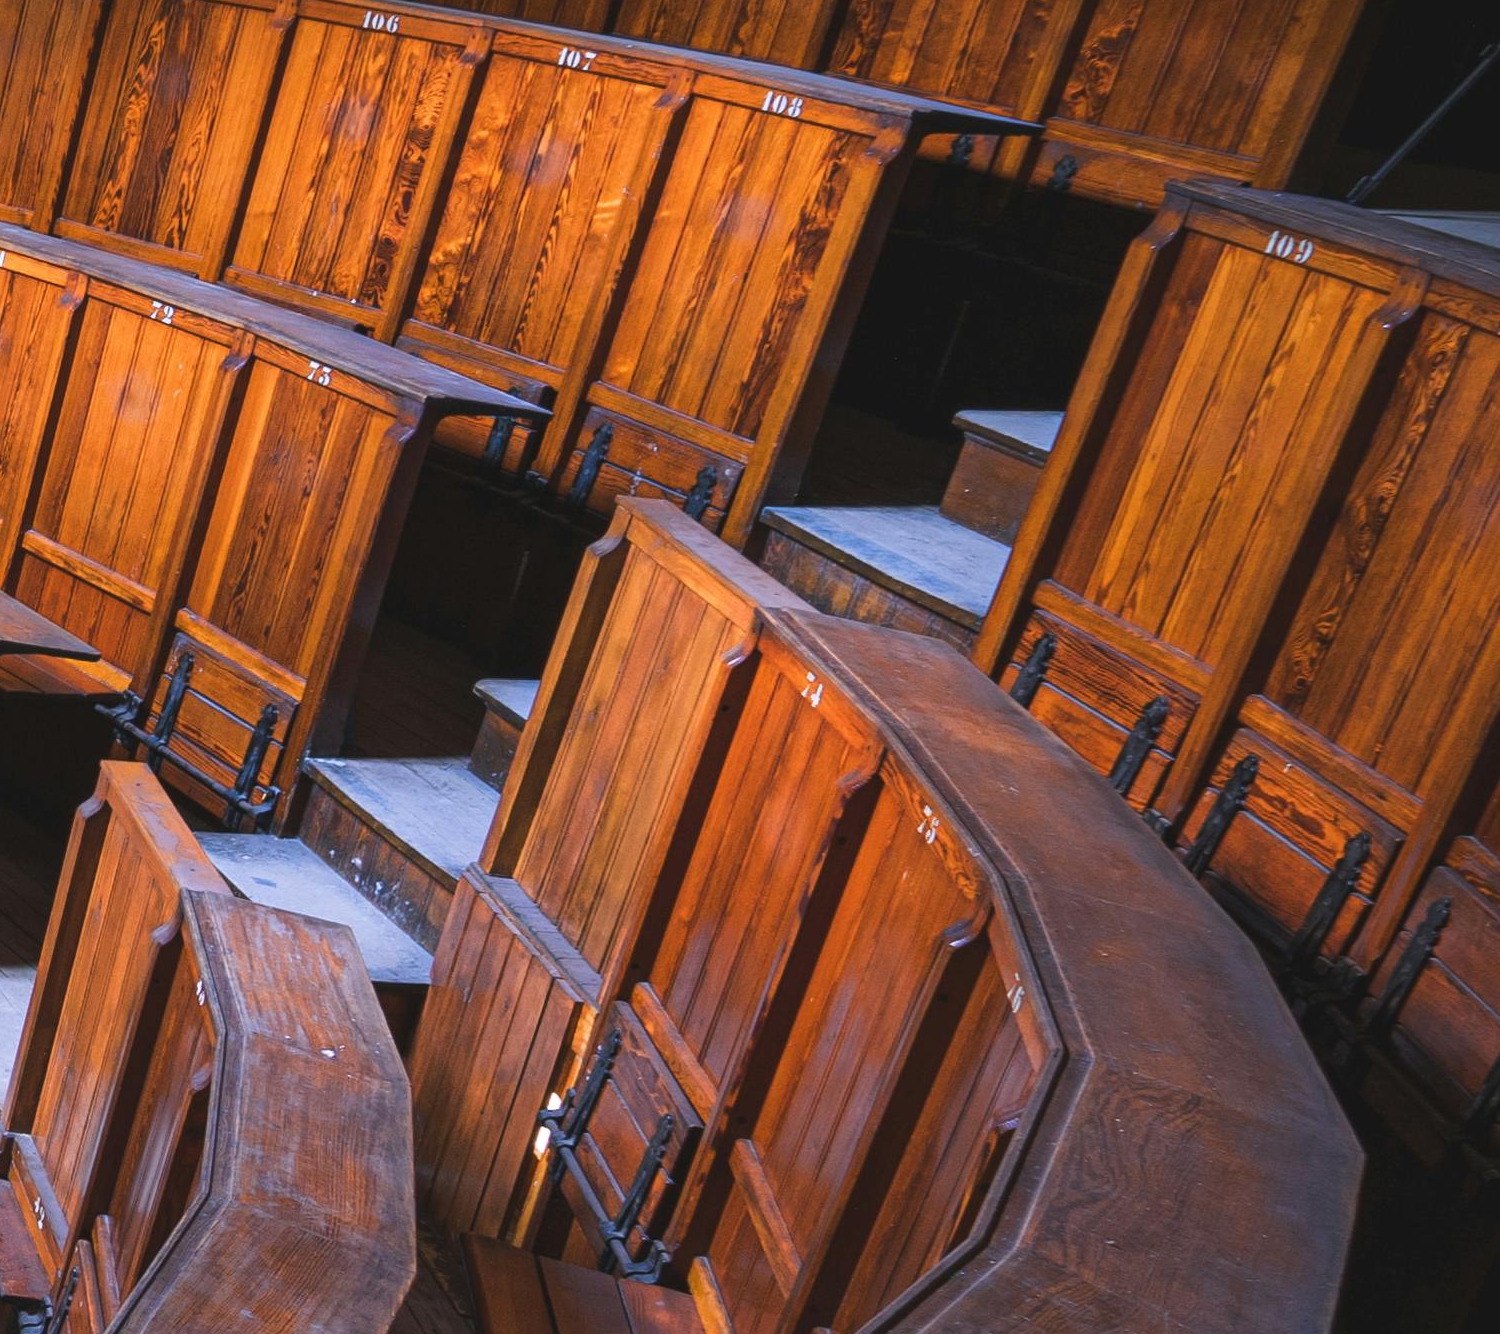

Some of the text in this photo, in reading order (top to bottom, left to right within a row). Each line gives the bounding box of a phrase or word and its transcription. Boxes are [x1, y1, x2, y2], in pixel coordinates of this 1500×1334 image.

[363, 11, 399, 32] 106
[558, 48, 596, 70] 107
[762, 92, 802, 117] 108
[1265, 231, 1314, 262] 109
[151, 301, 173, 324] 72
[307, 362, 330, 385] 73
[801, 672, 823, 707] 74
[917, 806, 939, 844] 75
